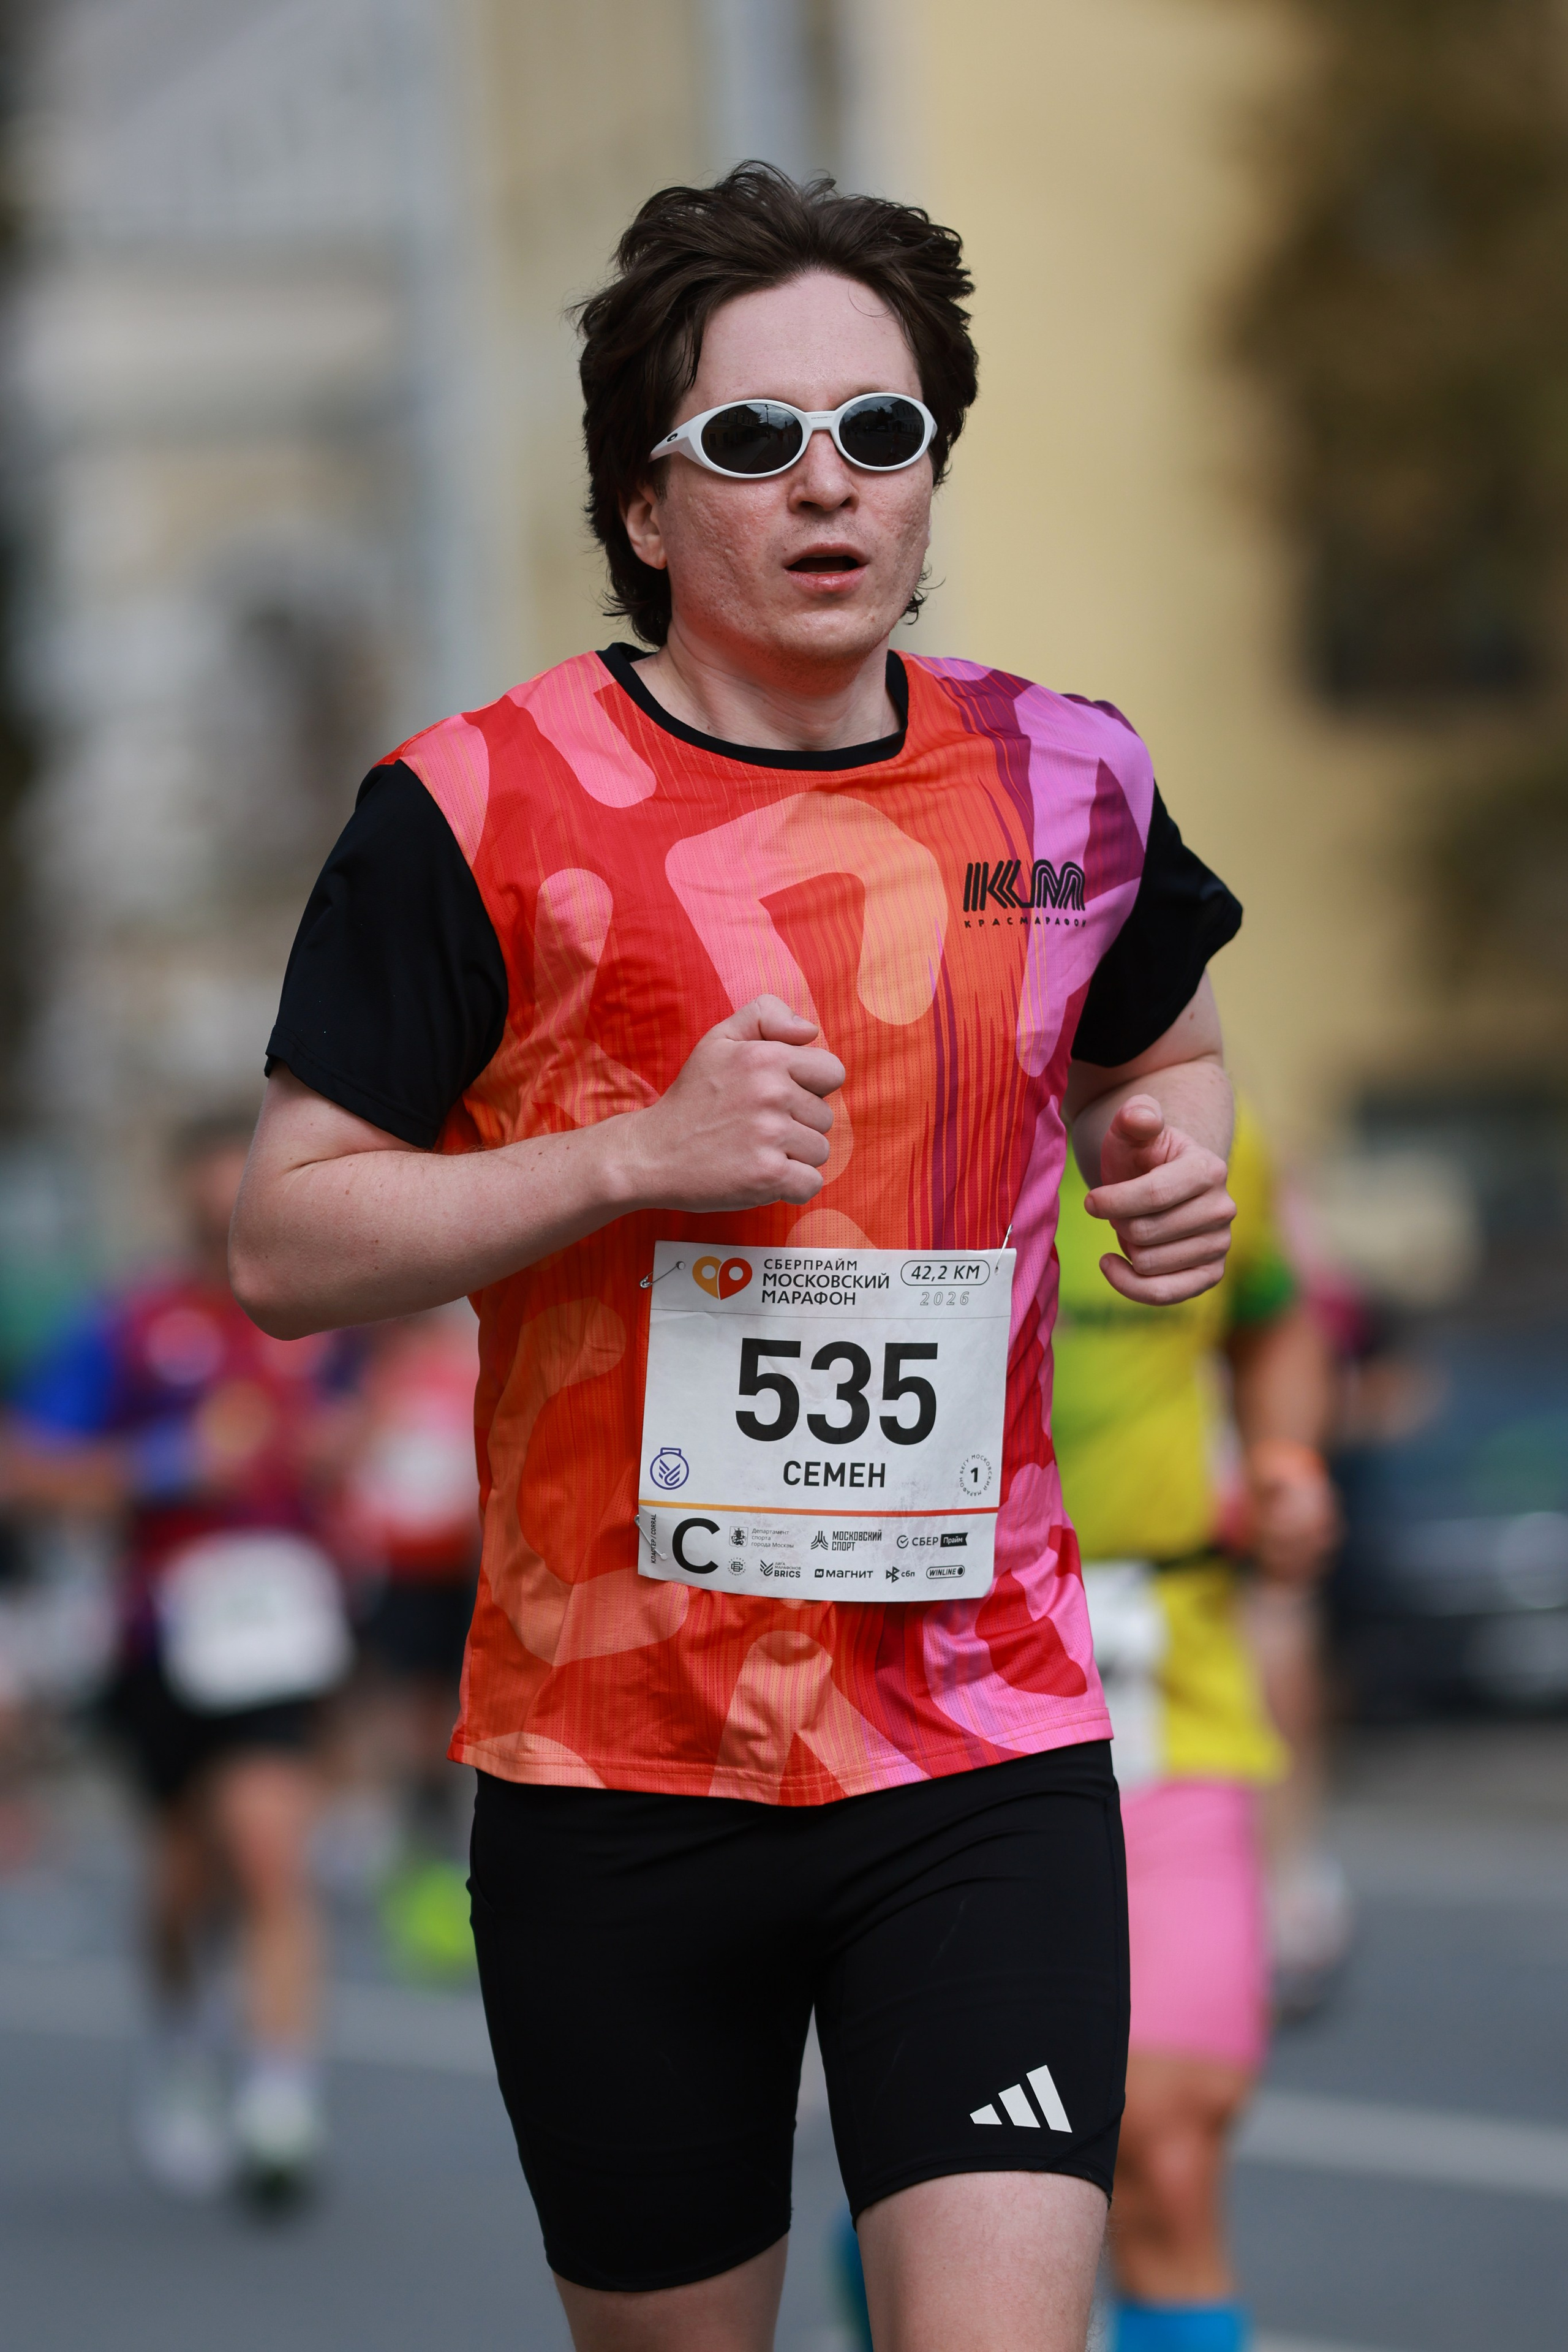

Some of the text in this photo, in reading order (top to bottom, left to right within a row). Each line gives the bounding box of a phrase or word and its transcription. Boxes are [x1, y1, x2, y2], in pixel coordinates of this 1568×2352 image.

[964, 916, 1086, 928] КРАСМАРАФОН
[764, 1258, 857, 1271] СБЕРПРАЙМ
[763, 1272, 889, 1289] МОСКОВСКИЙ
[911, 1265, 948, 1282] 42,2
[761, 1290, 856, 1305] МАРАФОН
[920, 1291, 969, 1306] 2026
[736, 1338, 938, 1446] 535
[783, 1460, 886, 1488] СЕМЕН
[970, 1467, 978, 1483] 1
[832, 1529, 882, 1541] МОСКОВСКИЙ
[912, 1536, 963, 1546] СБЕР Прайм
[832, 1542, 856, 1551] СПОРТ
